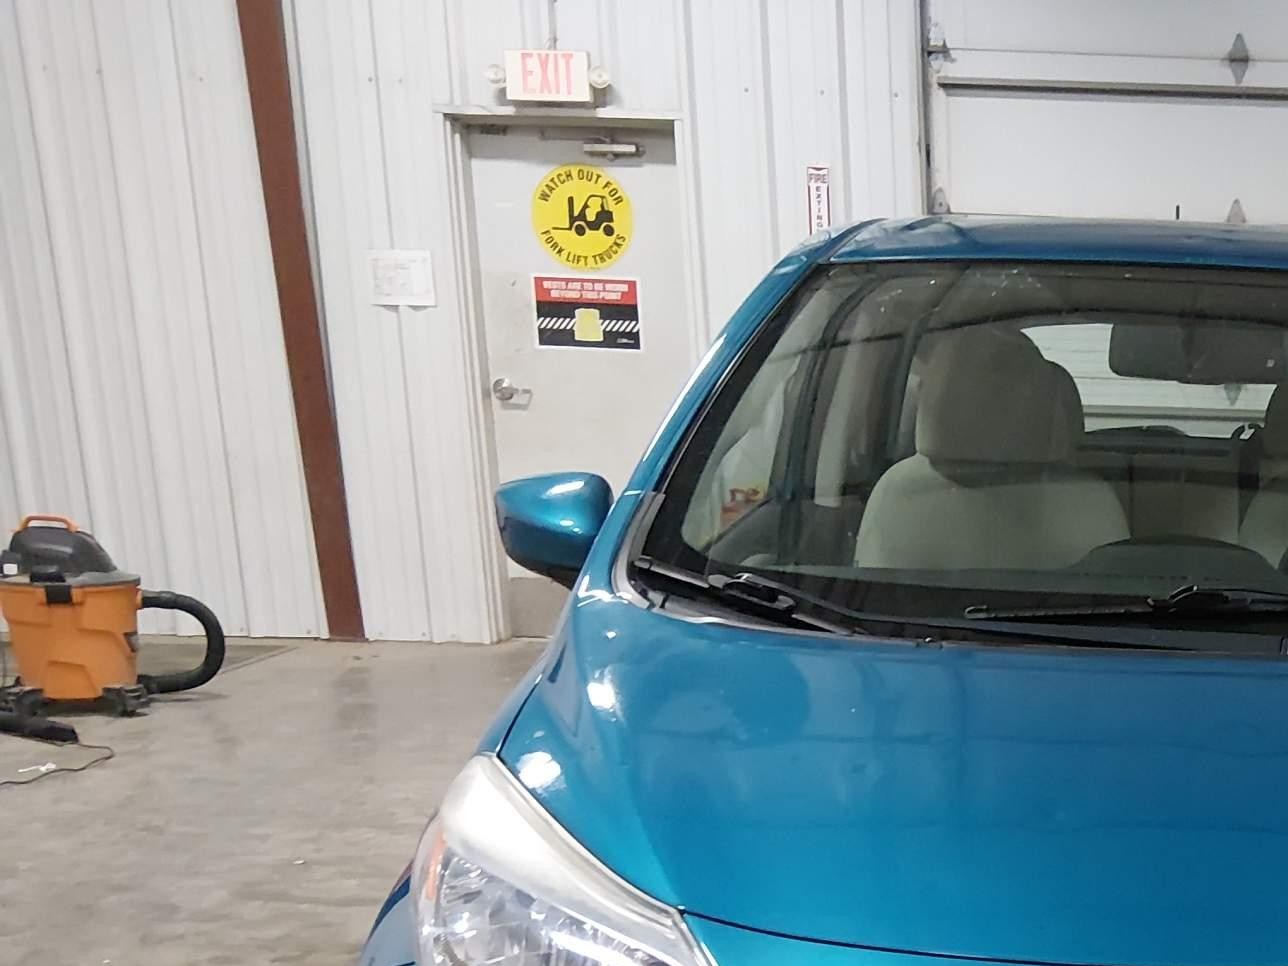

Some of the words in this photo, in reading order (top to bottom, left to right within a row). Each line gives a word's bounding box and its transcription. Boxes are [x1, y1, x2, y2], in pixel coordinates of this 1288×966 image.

[521, 52, 574, 95] EXIT
[538, 169, 574, 202] WATCH
[577, 168, 602, 185] OUT
[602, 181, 624, 206] FOR
[815, 186, 824, 231] EXTING
[541, 230, 566, 257] FORK
[566, 251, 589, 267] LIFT
[592, 233, 627, 265] TRUCKS
